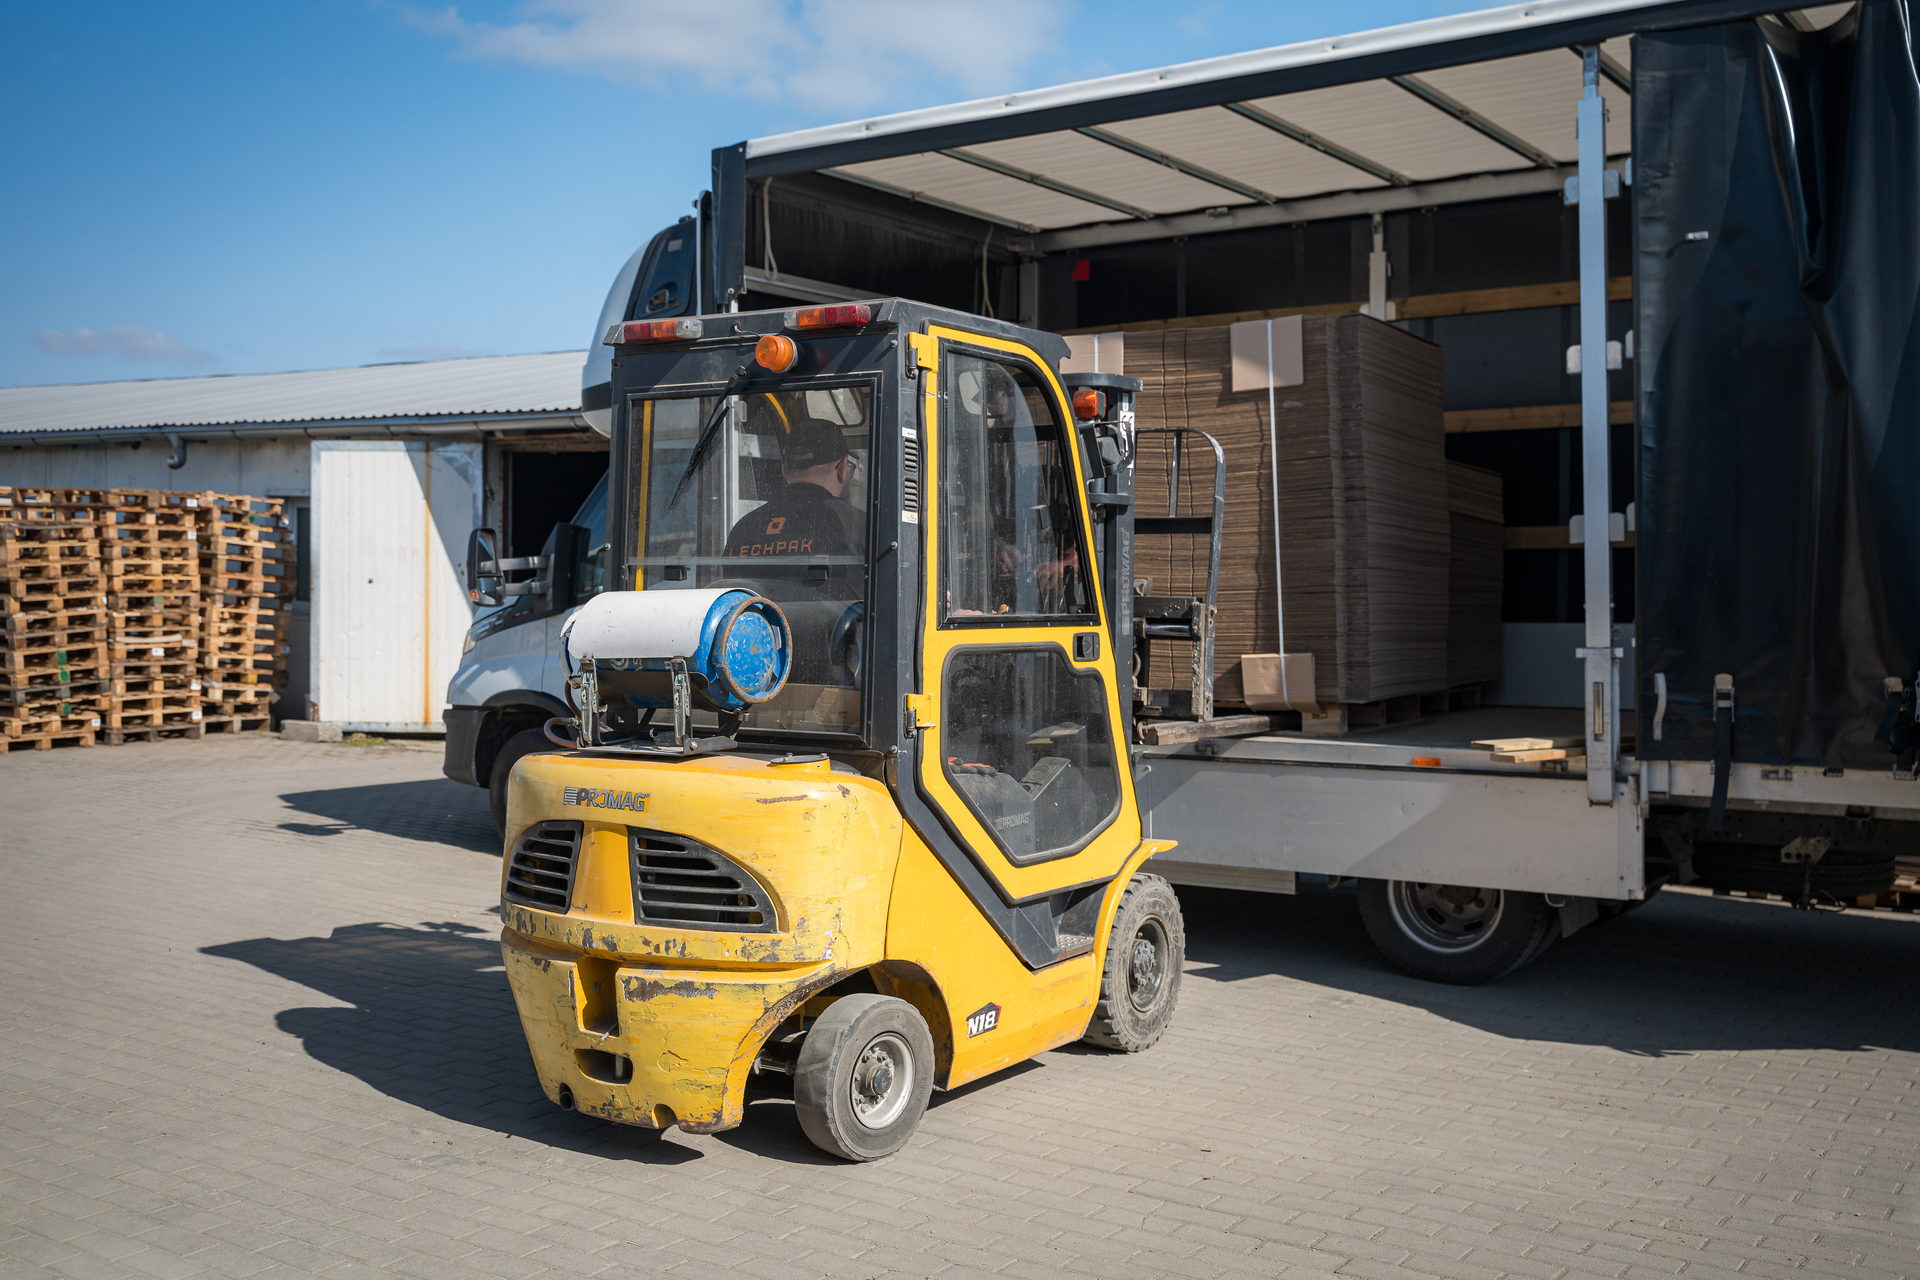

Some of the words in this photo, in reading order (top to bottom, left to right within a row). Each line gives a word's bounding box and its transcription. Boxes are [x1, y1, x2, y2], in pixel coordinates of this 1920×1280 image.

[1120, 531, 1131, 615] PROMAG
[577, 787, 646, 812] PROMAG
[968, 1010, 996, 1035] N18
